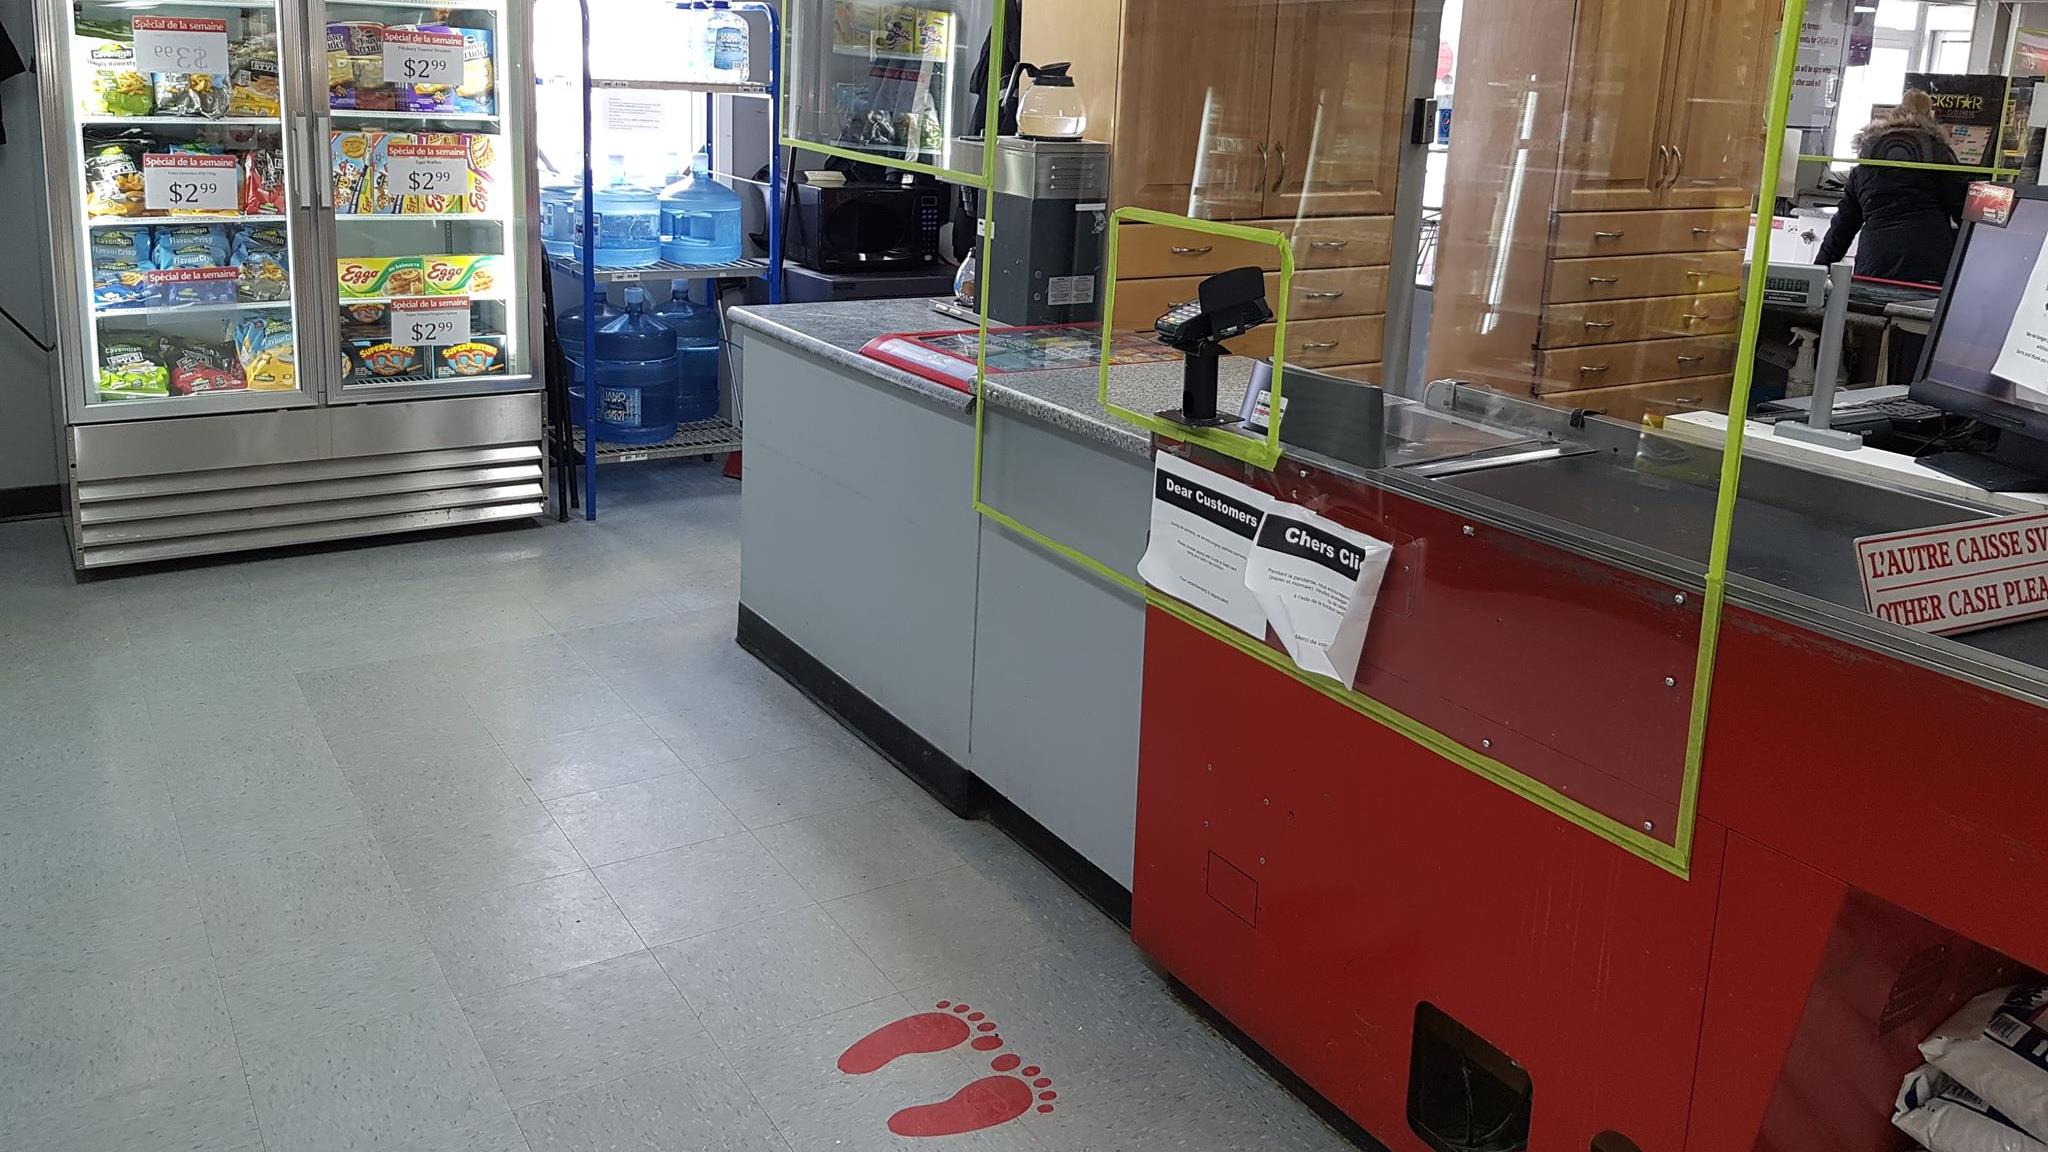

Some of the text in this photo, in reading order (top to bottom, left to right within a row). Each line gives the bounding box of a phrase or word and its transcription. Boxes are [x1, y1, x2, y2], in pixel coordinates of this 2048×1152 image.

[167, 20, 178, 29] de
[180, 20, 187, 30] la
[189, 21, 224, 31] semaine
[413, 33, 423, 42] de
[424, 34, 431, 43] la
[432, 35, 462, 46] semaine
[416, 147, 426, 155] de
[428, 147, 434, 155] la
[436, 148, 466, 156] semaine
[177, 157, 188, 166] de
[190, 157, 198, 166] la
[200, 158, 234, 167] semaine
[469, 178, 488, 213] Eggo
[182, 272, 192, 281] de
[194, 271, 200, 280] la
[202, 270, 236, 280] semaine
[341, 263, 380, 284] Eggo
[427, 262, 463, 282] Eggo
[420, 299, 429, 308] de
[430, 299, 437, 307] la
[438, 298, 468, 307] semaine
[442, 342, 499, 358] SUPERPRETZEL
[1166, 477, 1258, 528] Dear Customers
[1285, 527, 1335, 559] Chers
[1868, 526, 2048, 579] L'AUTRE CAISSE SV
[1876, 575, 2048, 627] OTHER CASH PLEA
